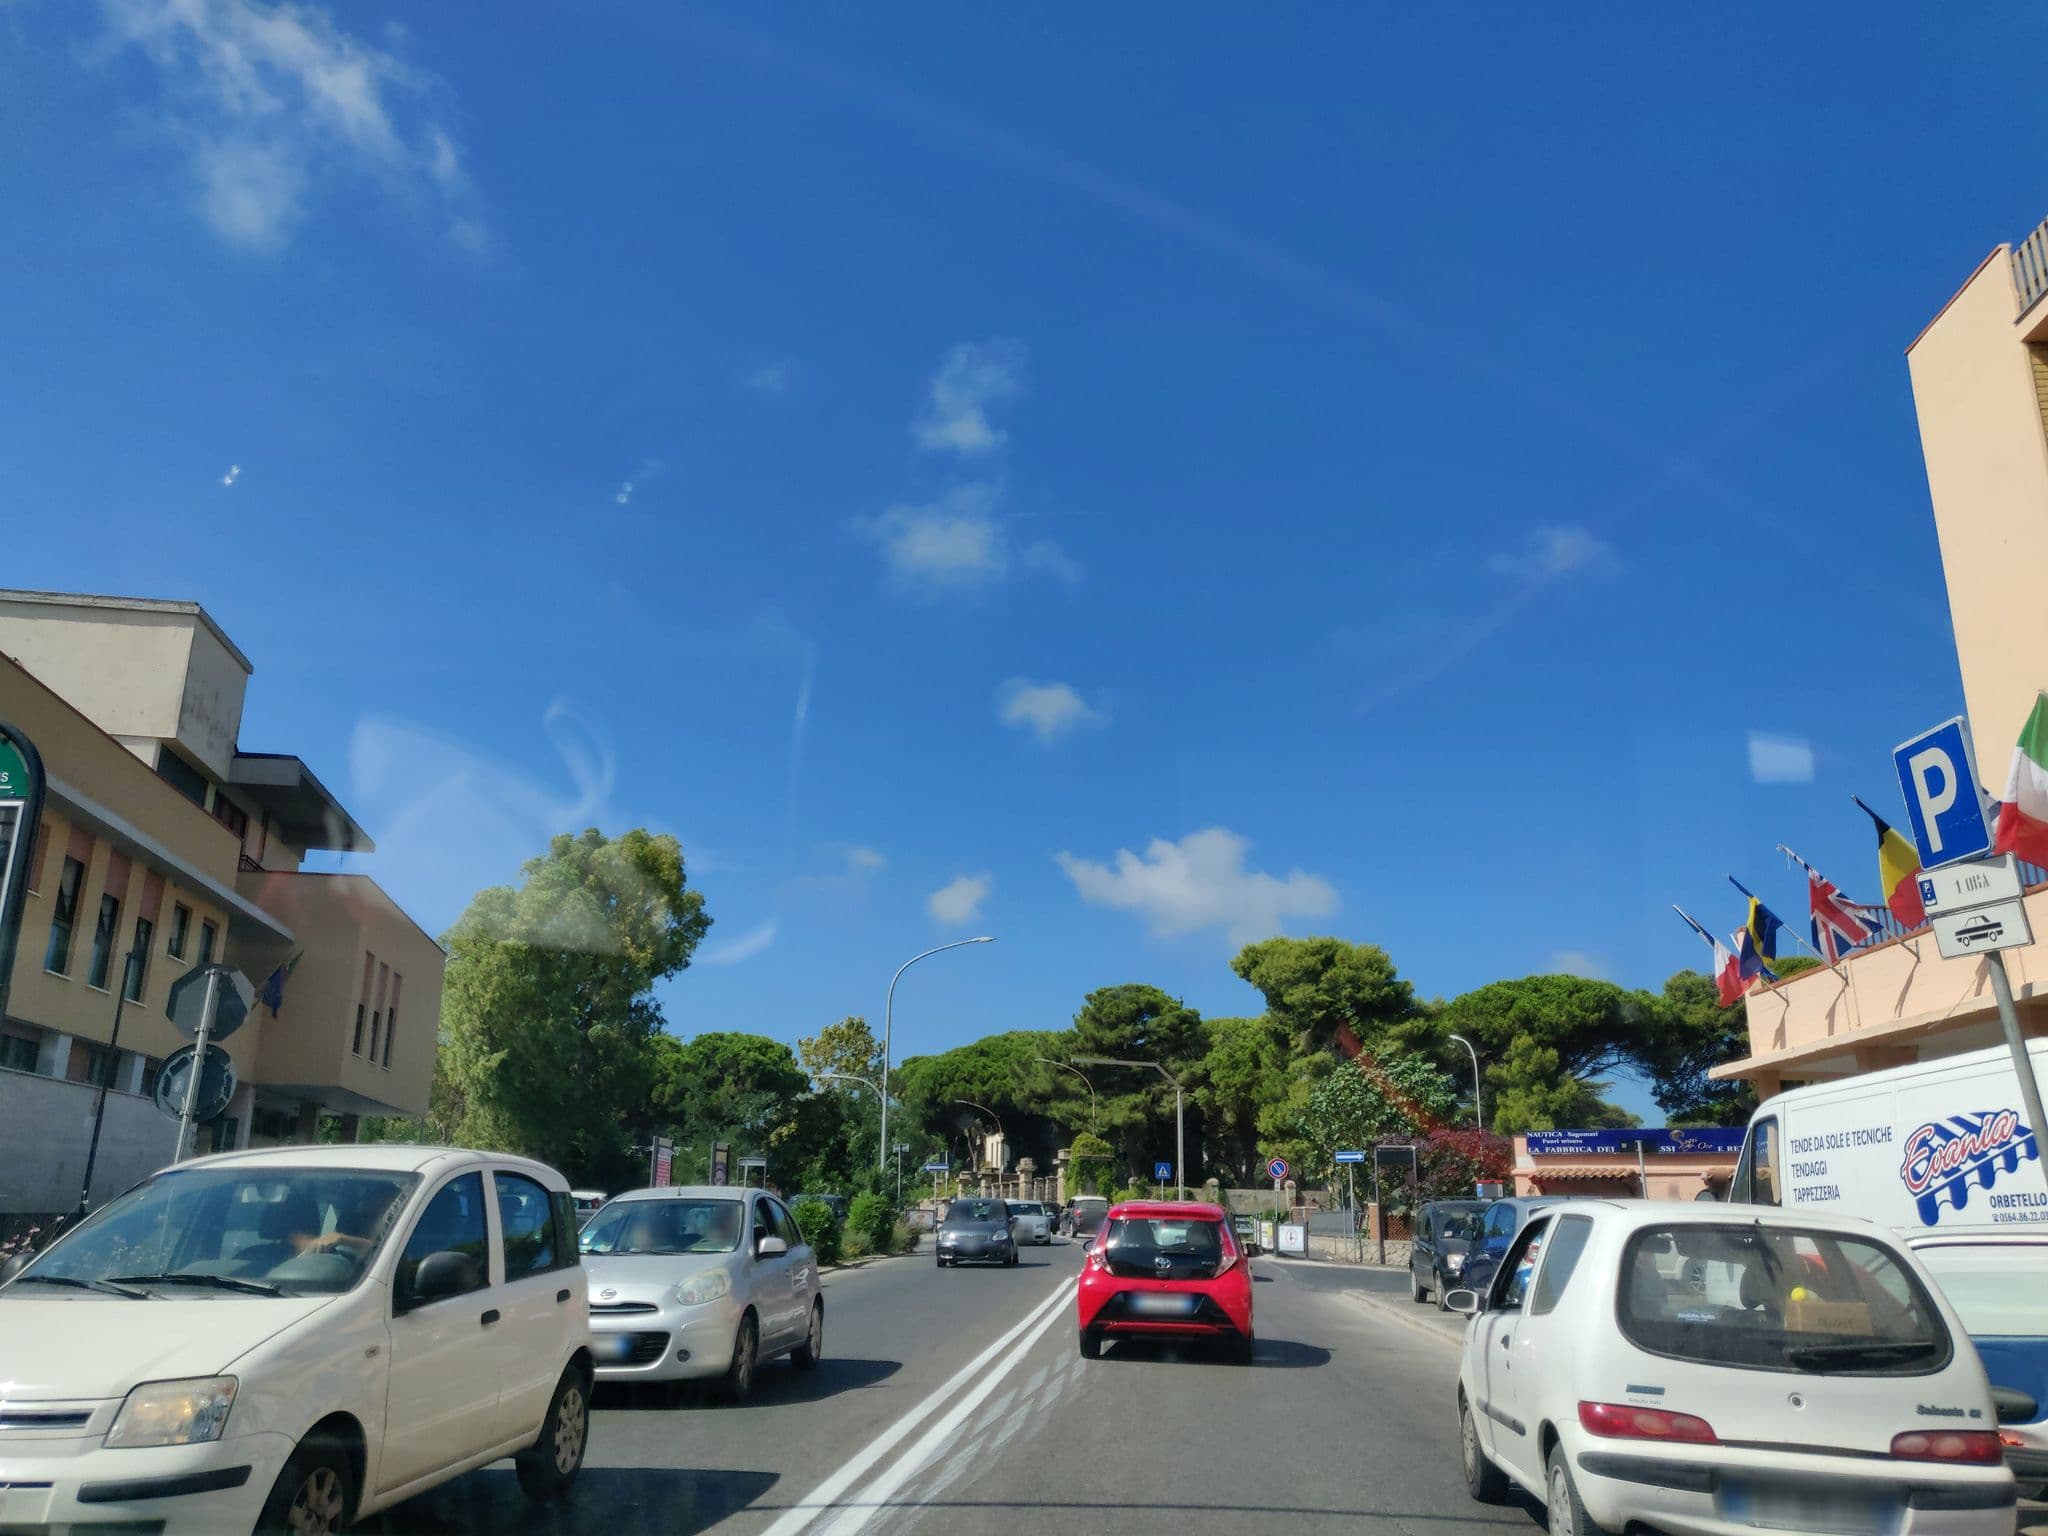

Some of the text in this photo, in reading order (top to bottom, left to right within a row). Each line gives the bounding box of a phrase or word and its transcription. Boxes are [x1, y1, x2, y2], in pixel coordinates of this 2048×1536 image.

[1908, 747, 1958, 854] P
[1790, 1126, 1892, 1154] TENDE DA SOLE E TECNICHE
[1791, 1160, 1827, 1178] TENDAGGI
[1793, 1185, 1840, 1203] TAPPEZZERIA
[1990, 1192, 2048, 1208] ORBETELLO
